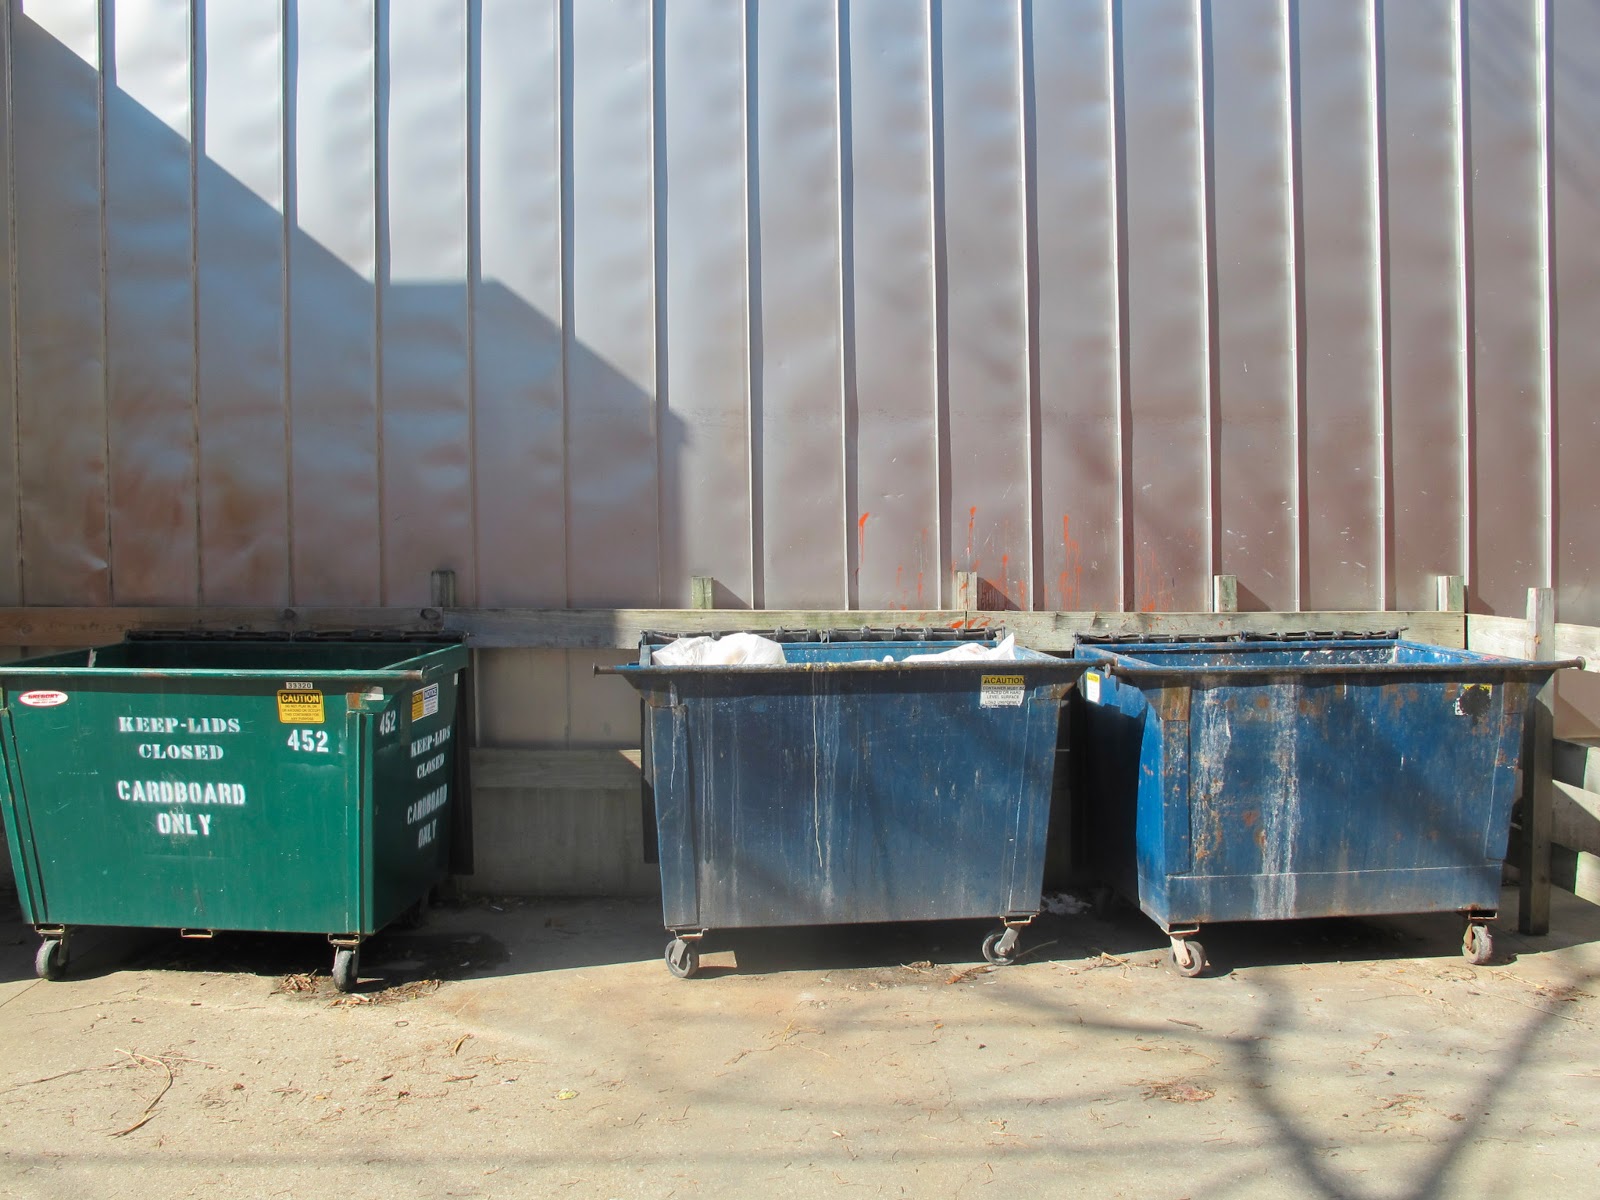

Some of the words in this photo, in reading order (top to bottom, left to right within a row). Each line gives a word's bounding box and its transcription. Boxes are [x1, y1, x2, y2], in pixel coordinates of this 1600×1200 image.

[282, 694, 319, 703] CAUTION
[118, 716, 241, 733] KEEP-LIDS
[379, 709, 396, 736] 452
[138, 743, 224, 760] CLOSED
[287, 729, 329, 753] 452
[411, 725, 451, 758] KEEP-LIDS
[416, 752, 445, 779] CLOSED
[117, 780, 246, 805] CARDBOARD
[407, 783, 448, 825] CARDBOARD
[157, 812, 211, 835] ONLY
[418, 818, 437, 849] ONLY
